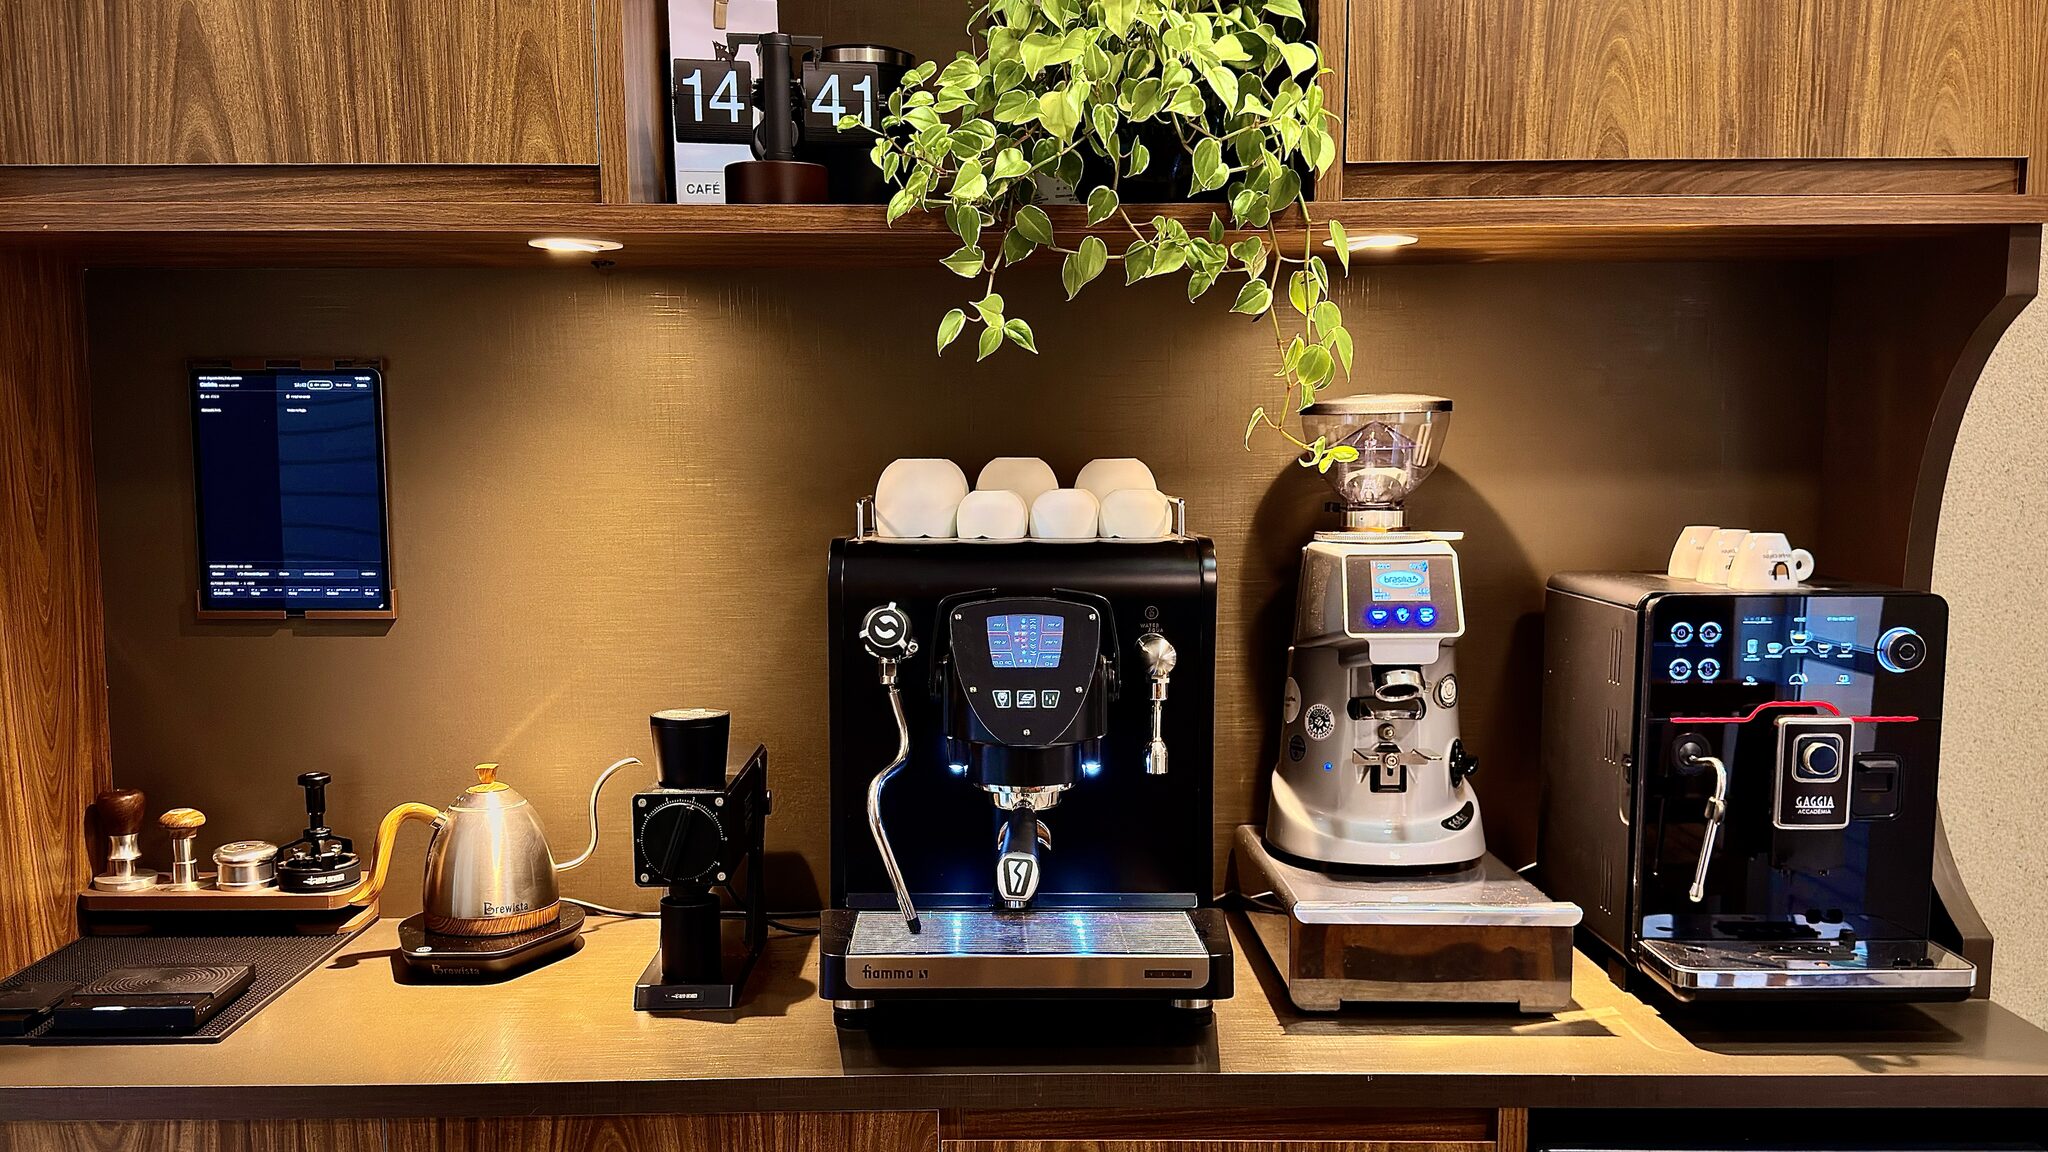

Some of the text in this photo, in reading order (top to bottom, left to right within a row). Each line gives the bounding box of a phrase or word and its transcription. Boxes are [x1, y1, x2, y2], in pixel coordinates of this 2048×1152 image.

[682, 69, 872, 128] 14 41
[686, 182, 721, 195] CAFÉ
[1795, 796, 1834, 808] GAGGIA
[483, 902, 529, 915] Brewista
[431, 964, 480, 975] Brewista
[862, 963, 914, 979] fiamma
